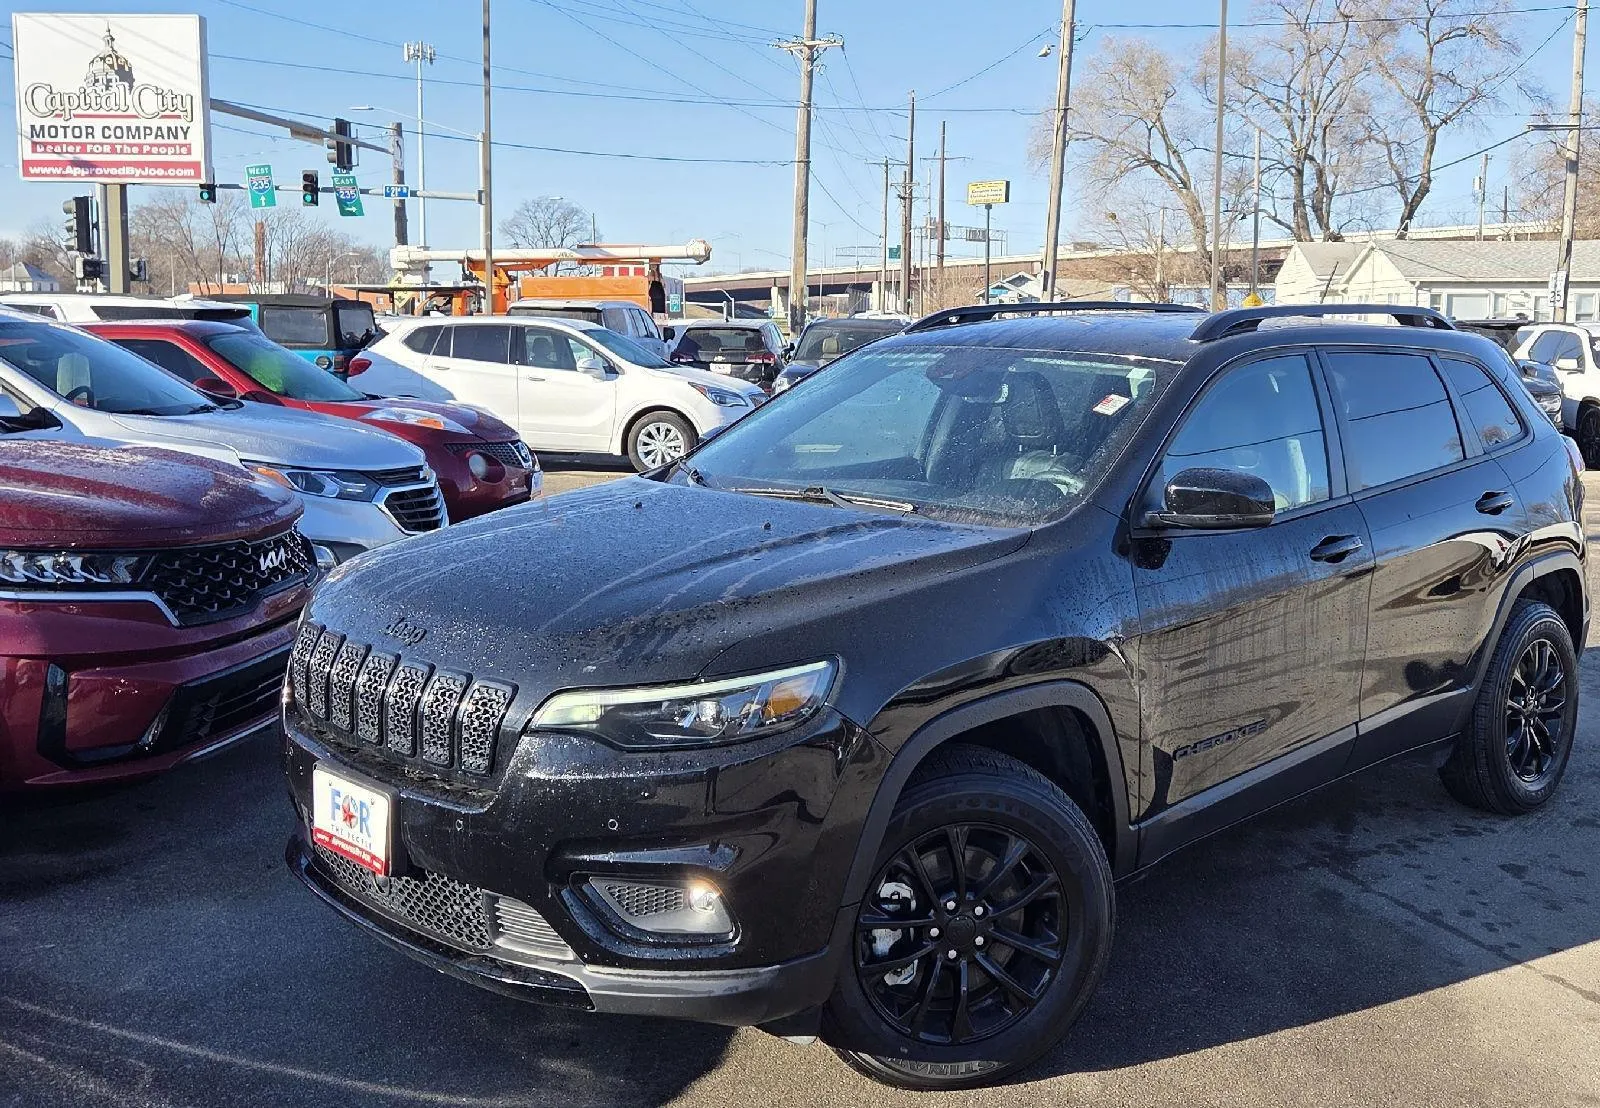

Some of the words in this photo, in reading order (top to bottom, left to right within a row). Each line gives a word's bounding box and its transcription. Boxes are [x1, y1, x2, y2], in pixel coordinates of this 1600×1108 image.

[25, 83, 129, 121] Capital
[132, 83, 194, 122] City
[30, 124, 95, 139] MOTOR
[101, 125, 191, 140] COMPANY
[36, 144, 82, 153] Dealer
[86, 144, 111, 153] FOR
[115, 145, 139, 154] The
[143, 145, 188, 155] People
[249, 167, 270, 175] WEST
[251, 179, 270, 189] 235
[338, 190, 357, 199] 235
[1550, 291, 1561, 303] 25
[259, 546, 287, 570] KIA
[384, 617, 428, 646] Jeep
[1172, 719, 1269, 761] CHEROKEE
